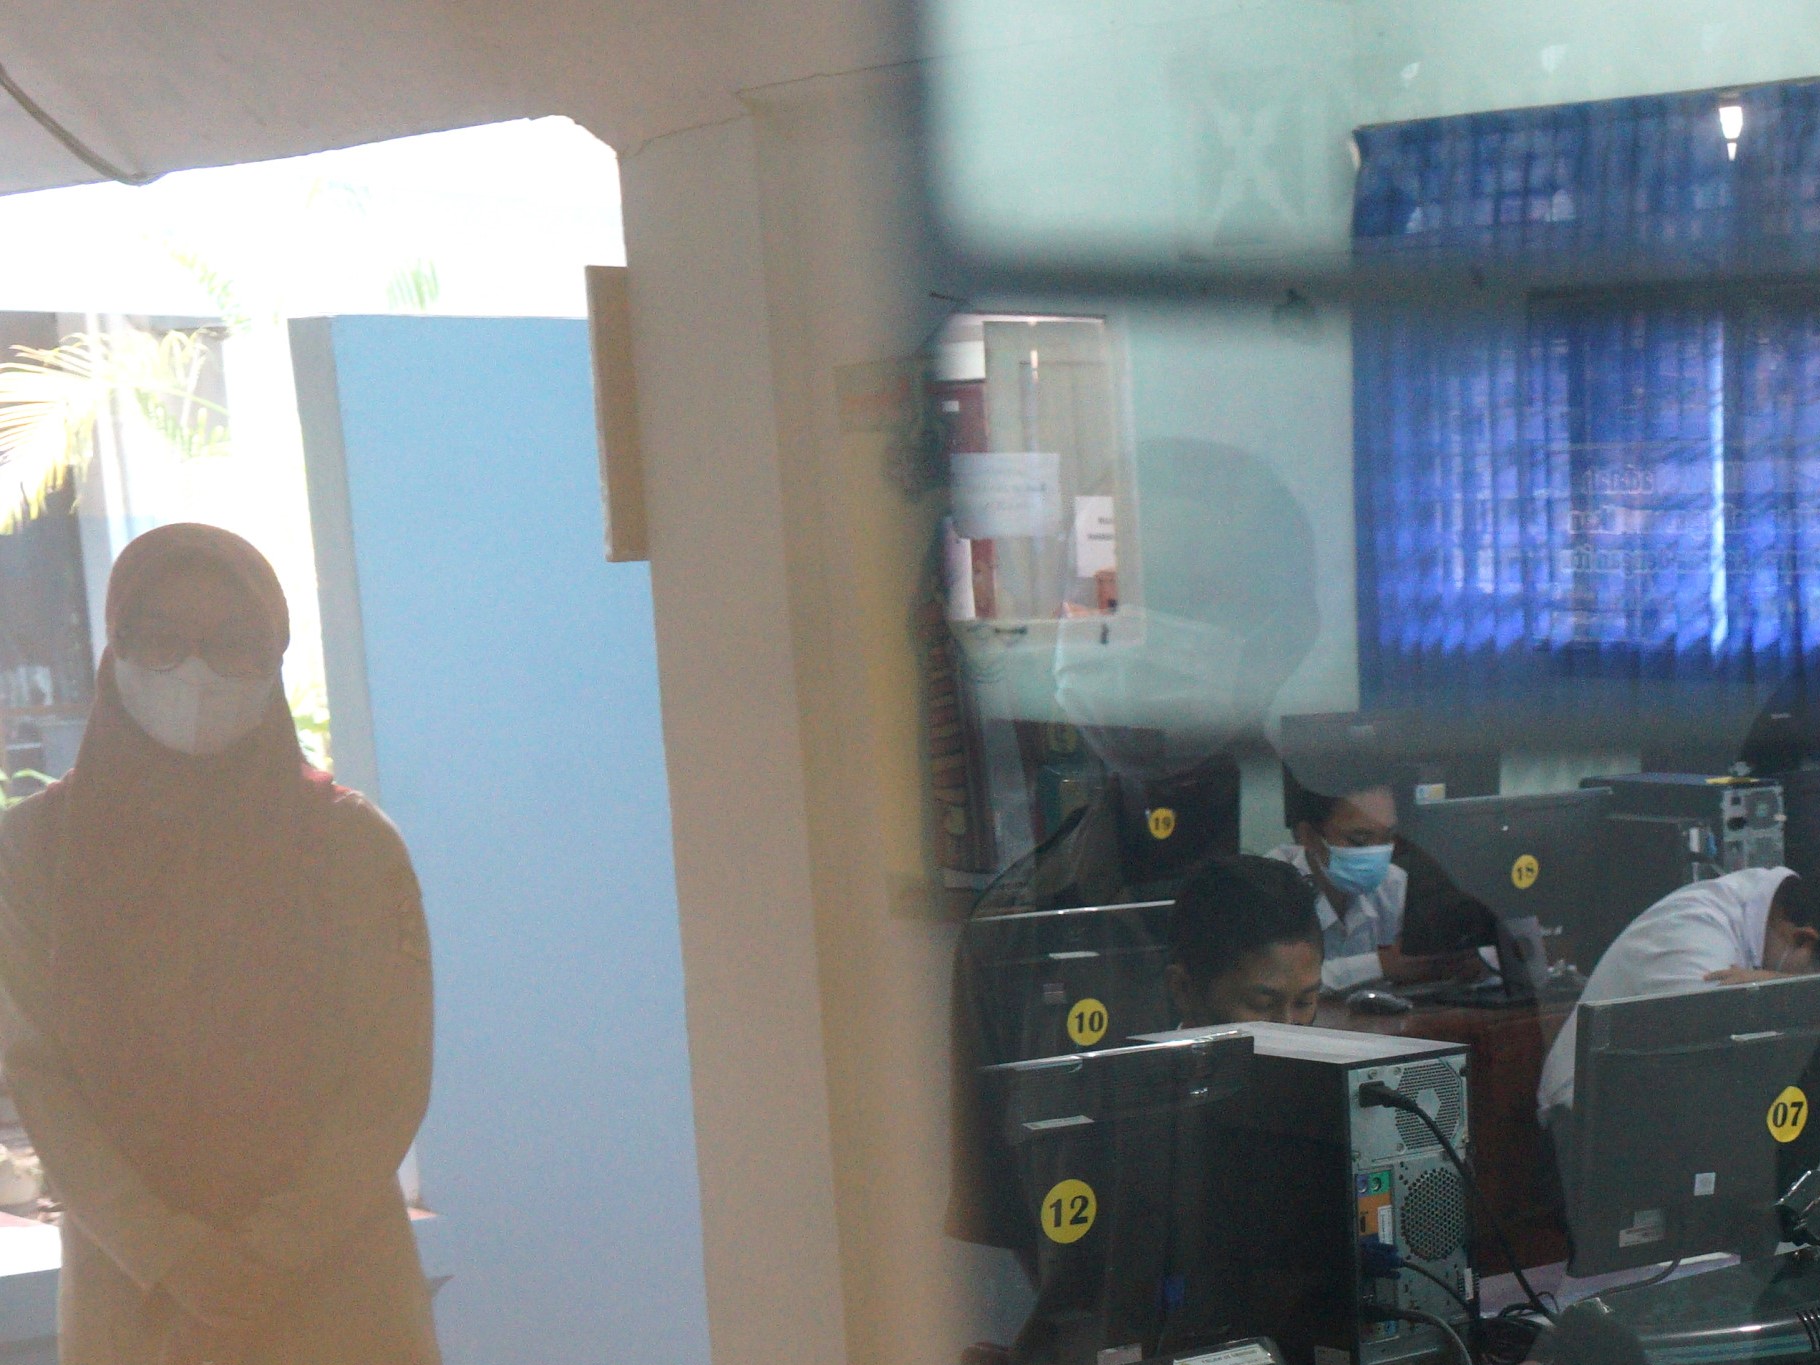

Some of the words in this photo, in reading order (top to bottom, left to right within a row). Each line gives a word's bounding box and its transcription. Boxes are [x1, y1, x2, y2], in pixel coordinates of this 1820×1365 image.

[1074, 1009, 1106, 1034] 10
[1772, 1101, 1805, 1129] 07
[1049, 1194, 1090, 1229] 12
